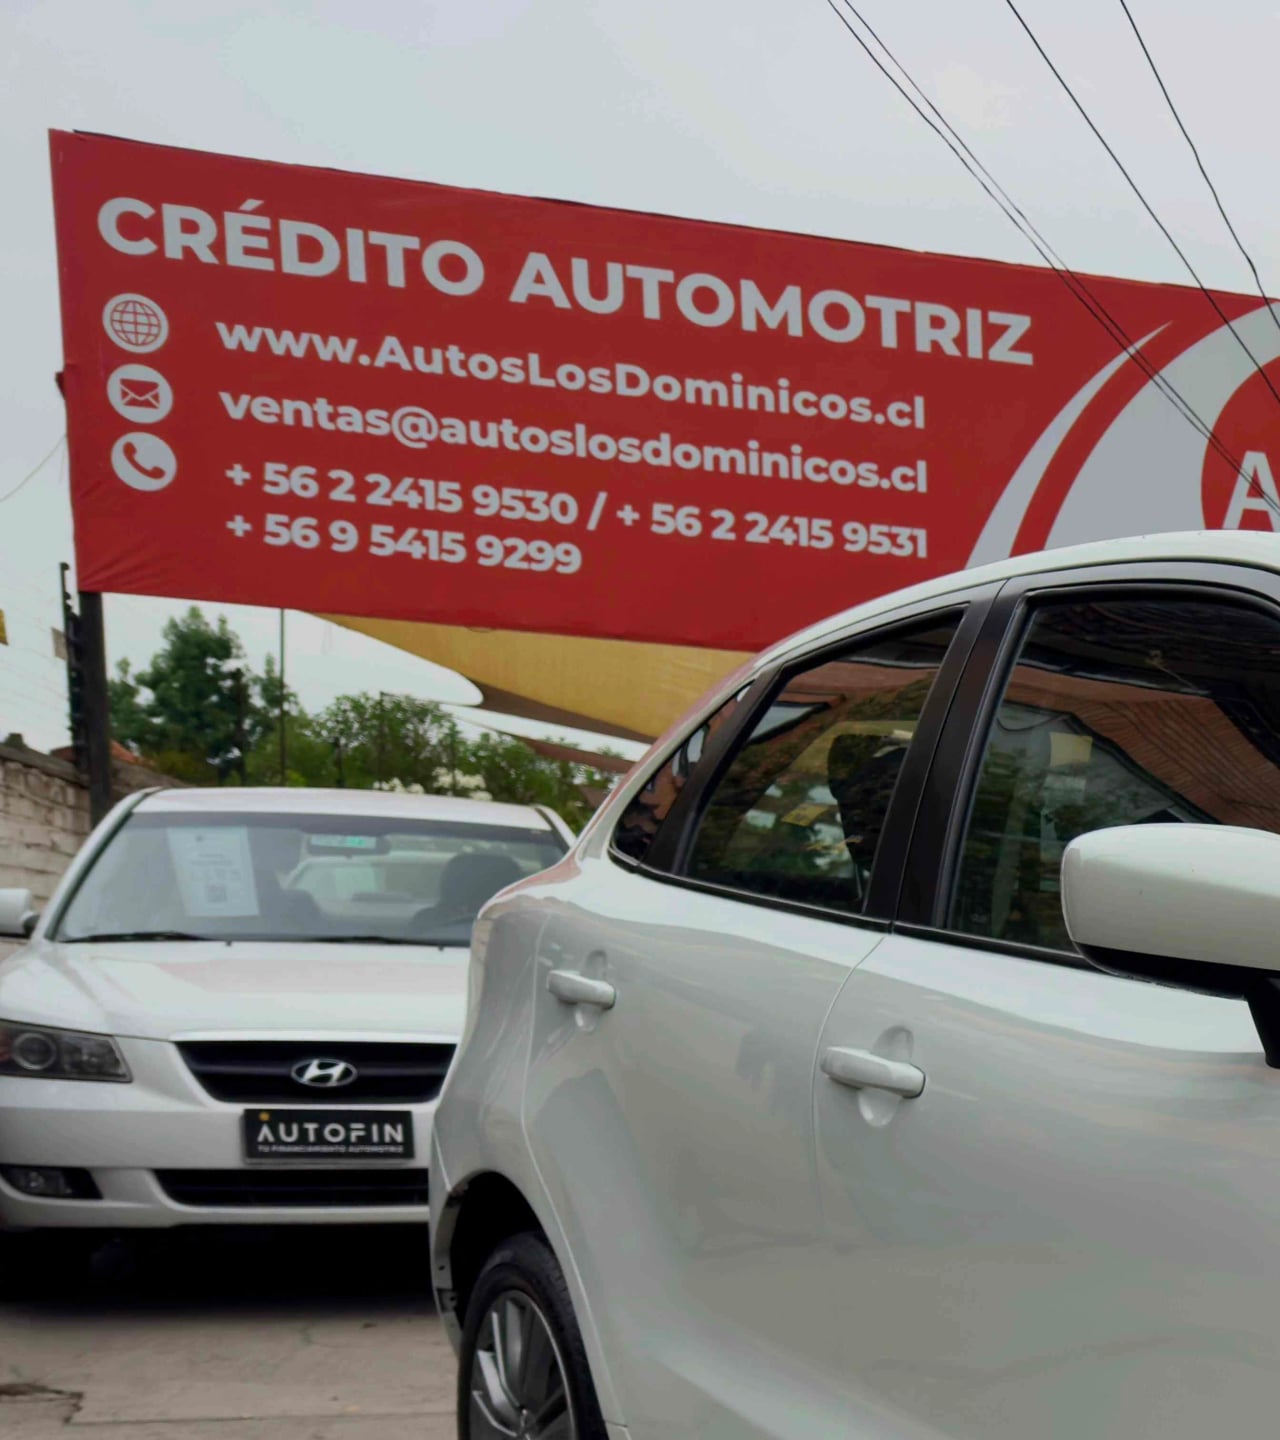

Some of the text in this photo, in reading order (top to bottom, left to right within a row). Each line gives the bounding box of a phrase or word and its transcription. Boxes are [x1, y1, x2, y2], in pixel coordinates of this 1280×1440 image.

[97, 196, 1034, 366] CRÉDITO AUTOMOTRIZ
[215, 321, 926, 429] www.AutosLosDominicos.cl
[219, 390, 927, 493] ventas@autoslosdominicos.cl
[262, 462, 319, 498] 56
[327, 469, 356, 502] 2
[364, 473, 462, 513] 2415
[471, 484, 579, 525] 9530
[651, 502, 702, 537] 56
[710, 509, 736, 540] 2
[744, 512, 833, 549] 2415
[842, 522, 928, 559] 9531
[263, 513, 320, 549] 56
[328, 520, 358, 552] 9
[369, 524, 467, 564] 5415
[474, 534, 582, 574] 9299
[257, 1122, 404, 1143] AUTOFIN
